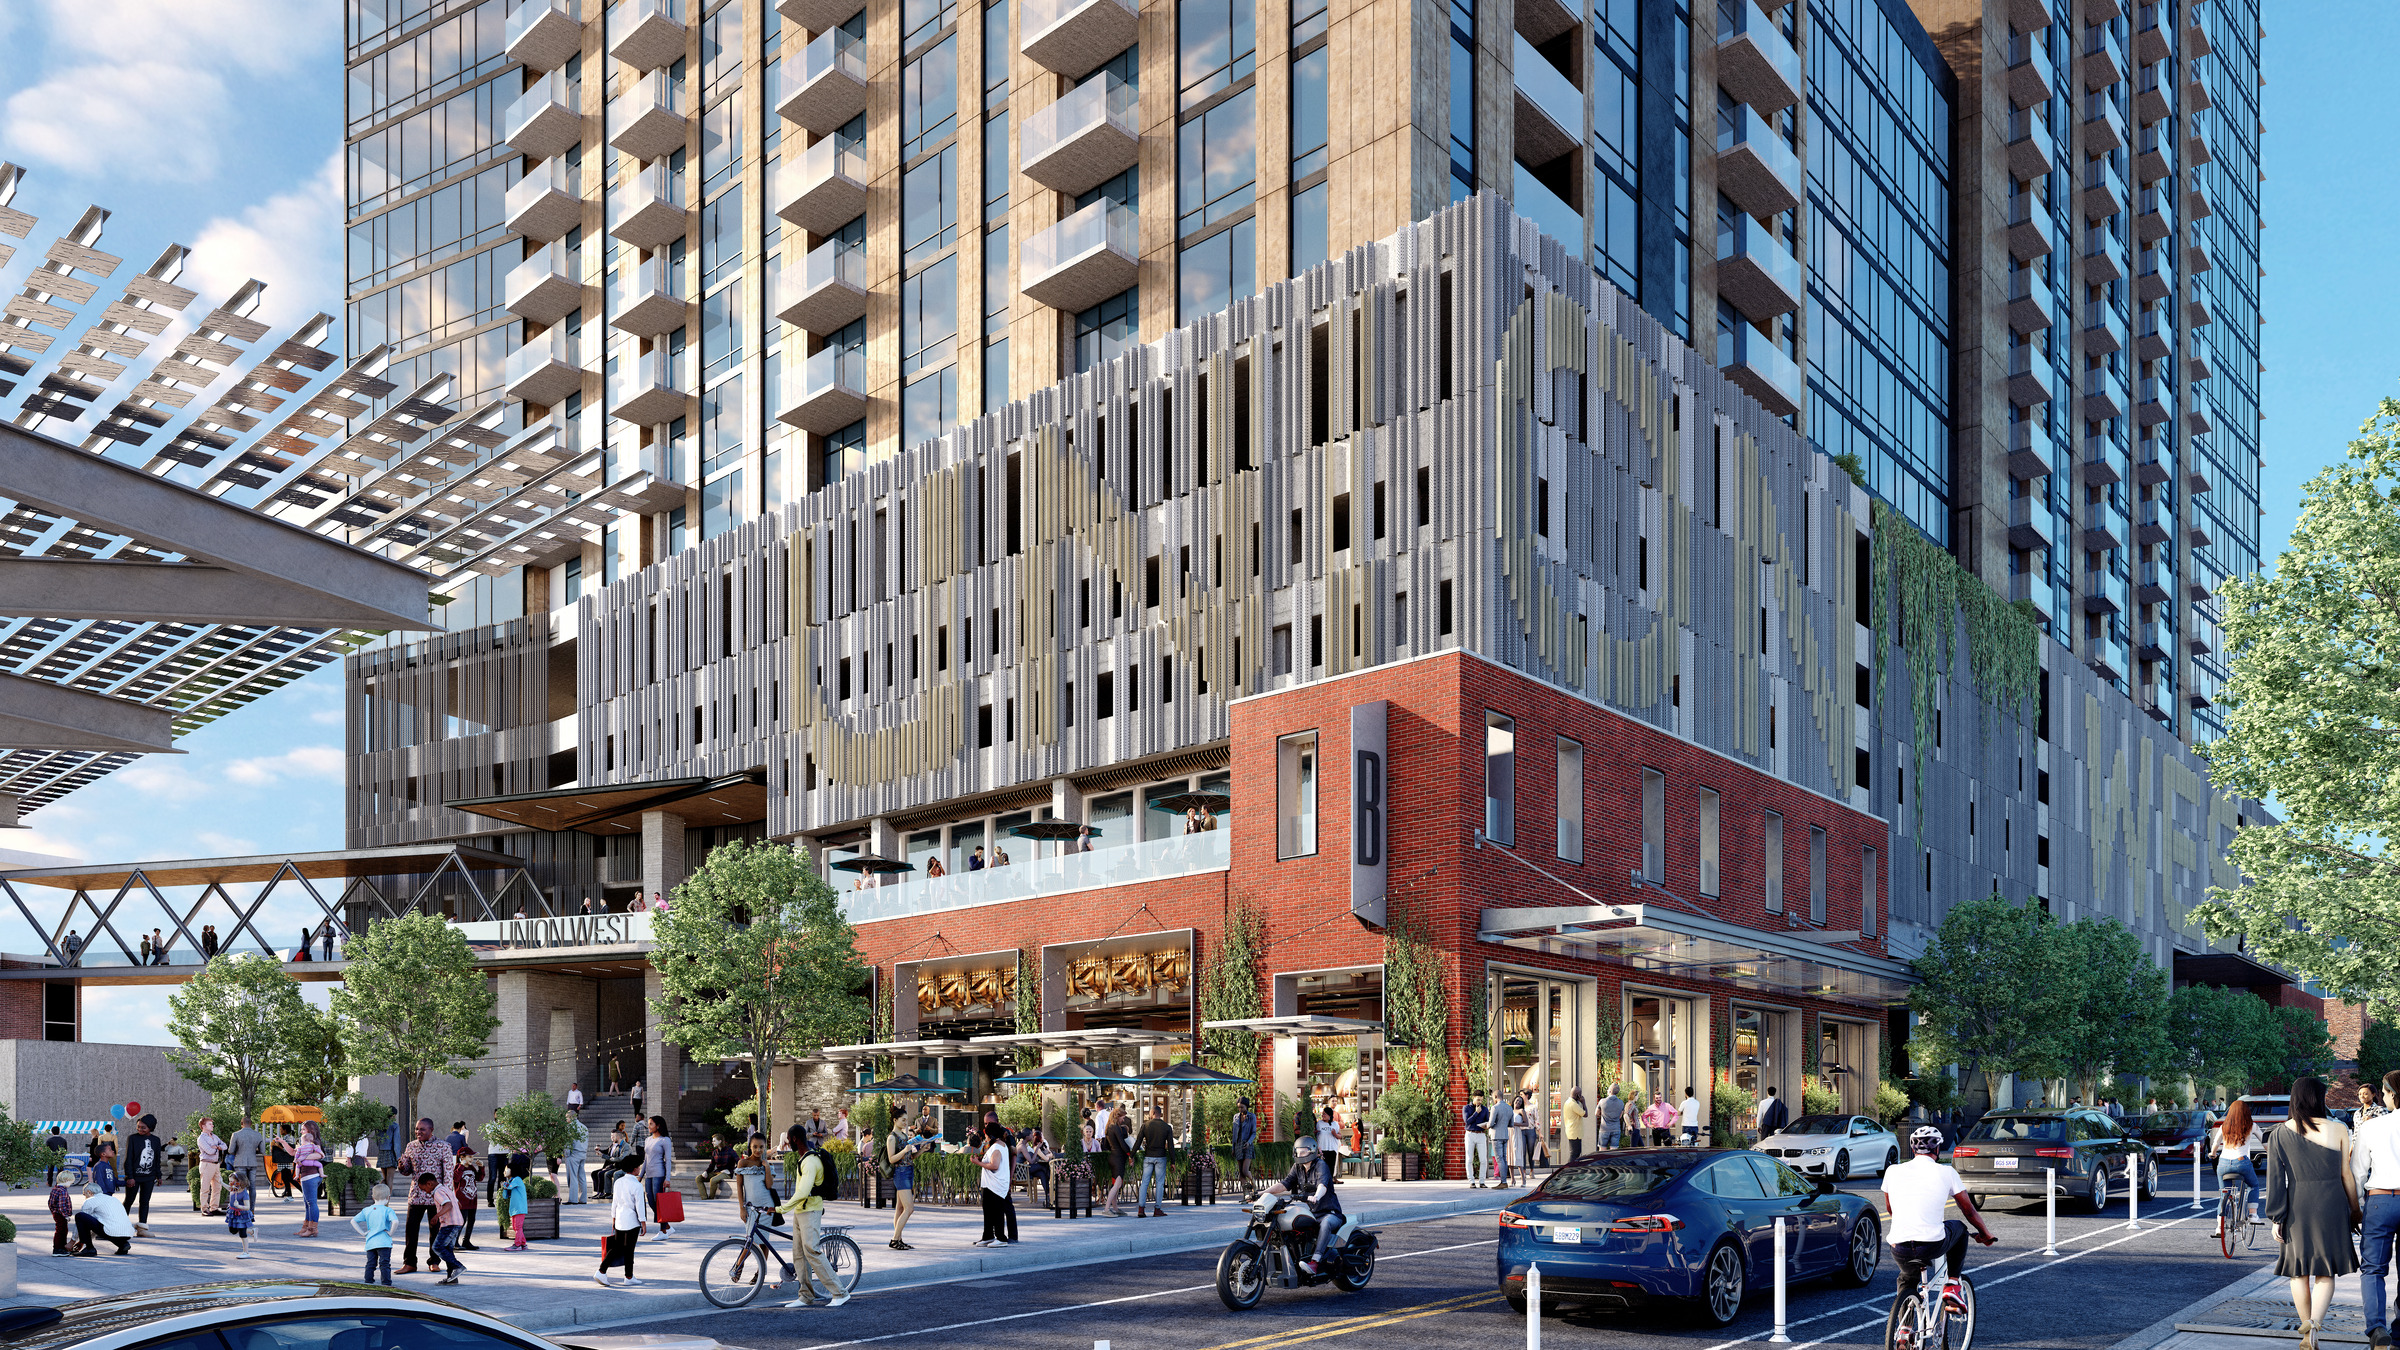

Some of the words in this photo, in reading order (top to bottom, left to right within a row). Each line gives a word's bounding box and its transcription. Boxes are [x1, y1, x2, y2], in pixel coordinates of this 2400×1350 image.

[1357, 749, 1381, 866] B
[499, 917, 565, 950] UNION
[569, 913, 634, 947] WEST
